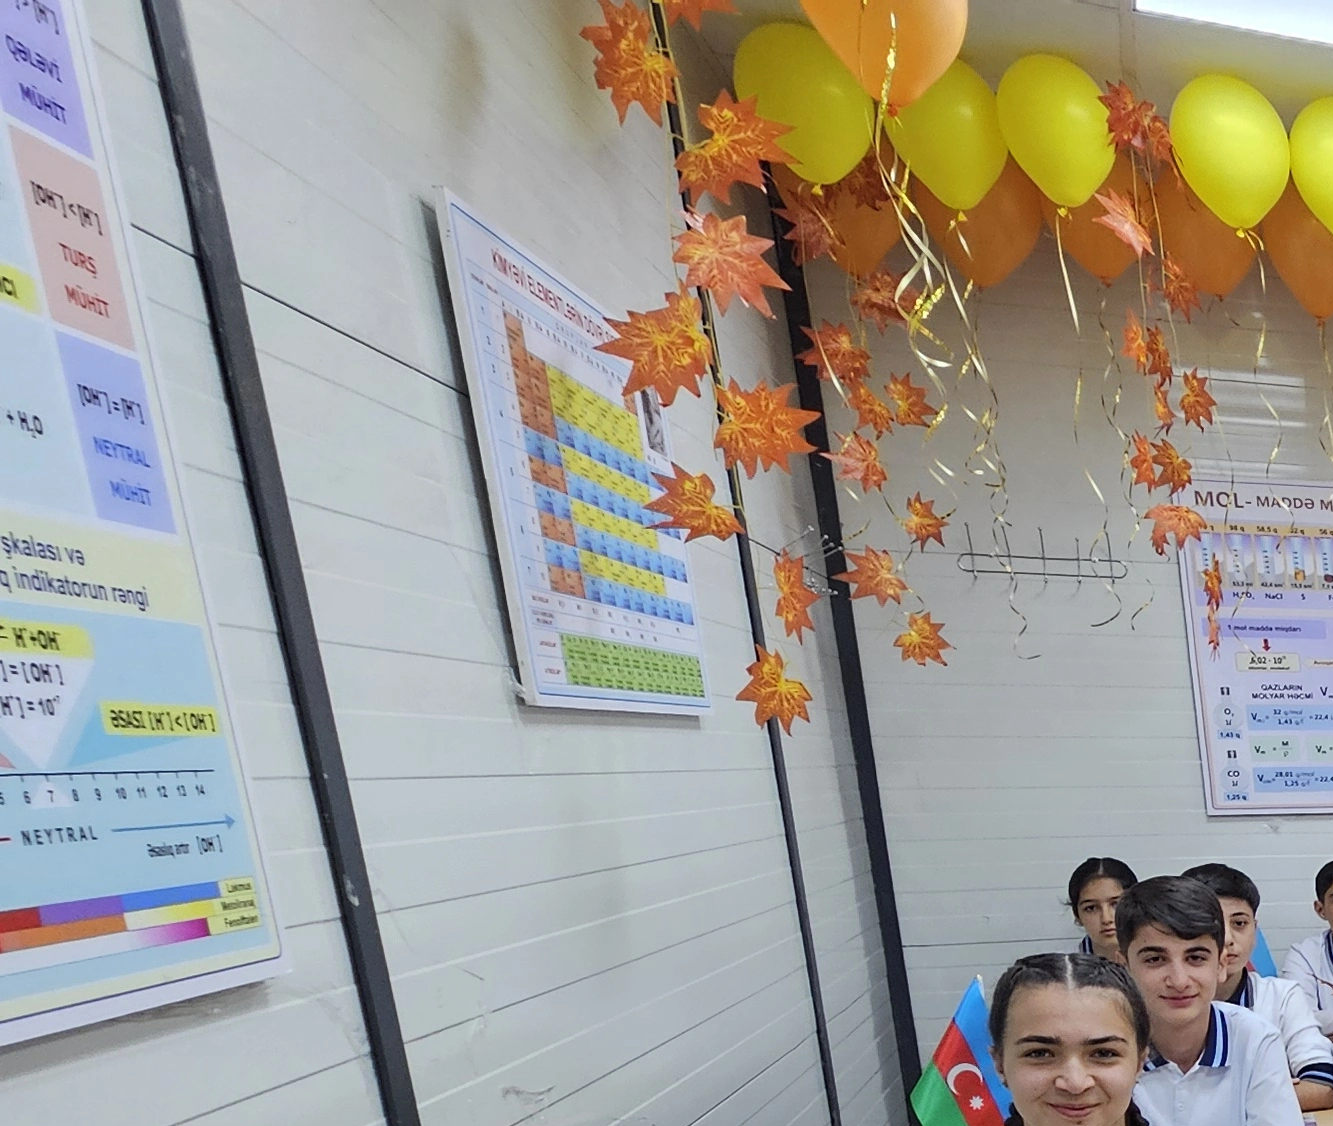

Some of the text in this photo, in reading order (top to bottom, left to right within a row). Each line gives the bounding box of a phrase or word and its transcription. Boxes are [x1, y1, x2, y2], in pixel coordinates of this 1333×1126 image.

[18, 82, 67, 124] MÜHİT
[59, 243, 97, 279] TURŞ
[64, 284, 110, 318] MÜHİT
[93, 436, 151, 468] NEYTRAL
[109, 478, 151, 506] MÜHİT
[0, 531, 85, 566] şkalası və
[12, 566, 108, 601] indikatorun
[110, 586, 150, 612] rəngi
[20, 826, 98, 846] NEYTRAL
